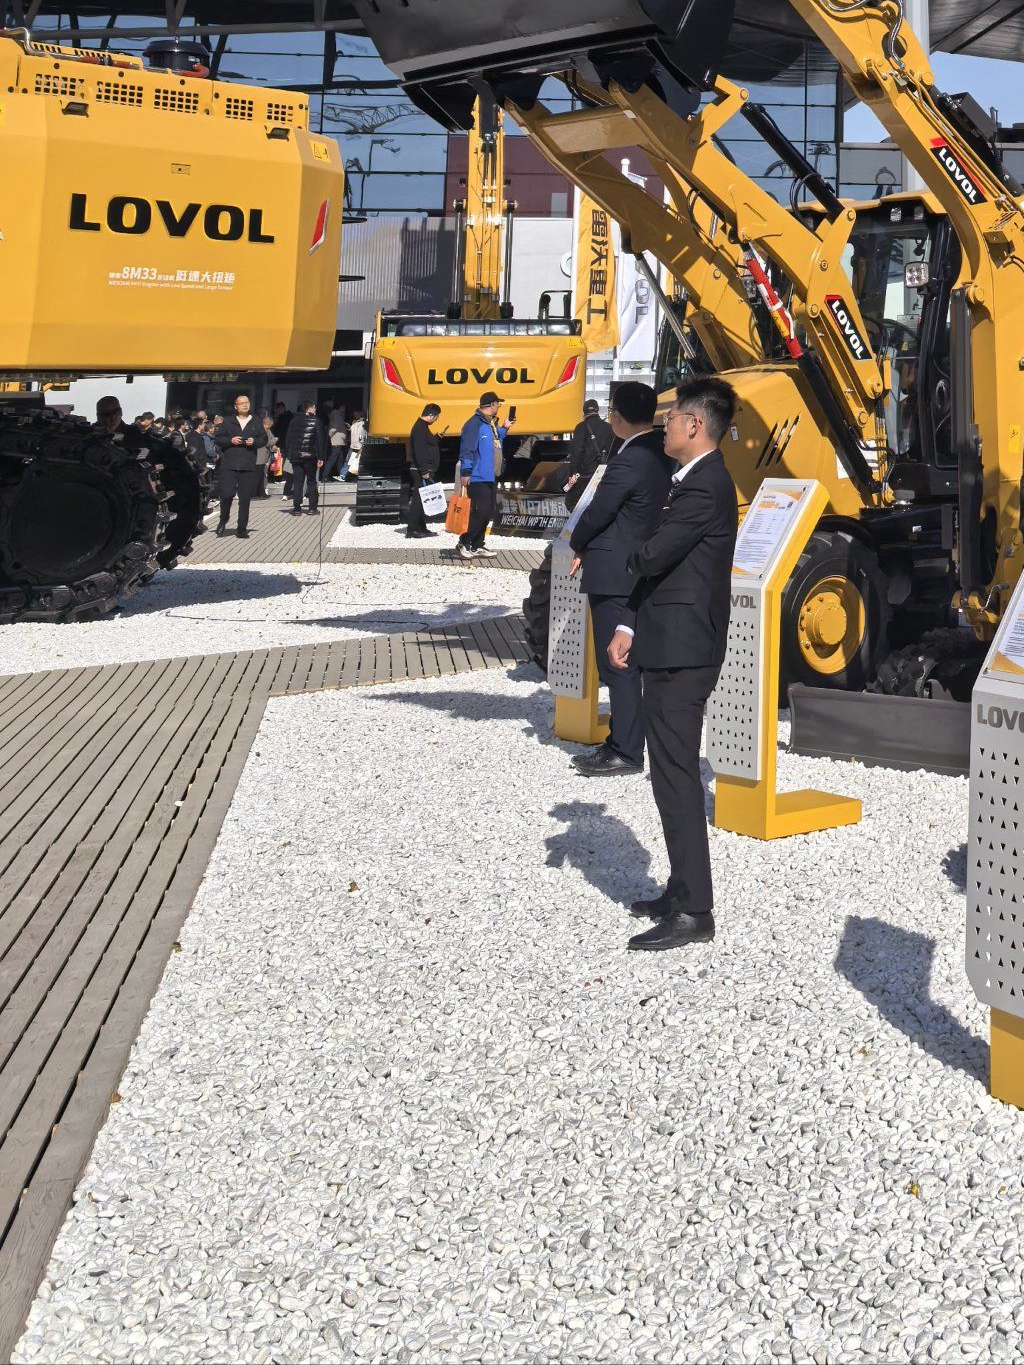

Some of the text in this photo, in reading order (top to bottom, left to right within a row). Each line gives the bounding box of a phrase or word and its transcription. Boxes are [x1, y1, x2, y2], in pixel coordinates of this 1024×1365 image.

[939, 147, 978, 204] LOVOL
[69, 192, 275, 244] LOVOL
[587, 209, 608, 325] 雷沃重工
[831, 300, 864, 359] LOVOL
[427, 367, 536, 385] LOVOL
[730, 594, 757, 609] VOL
